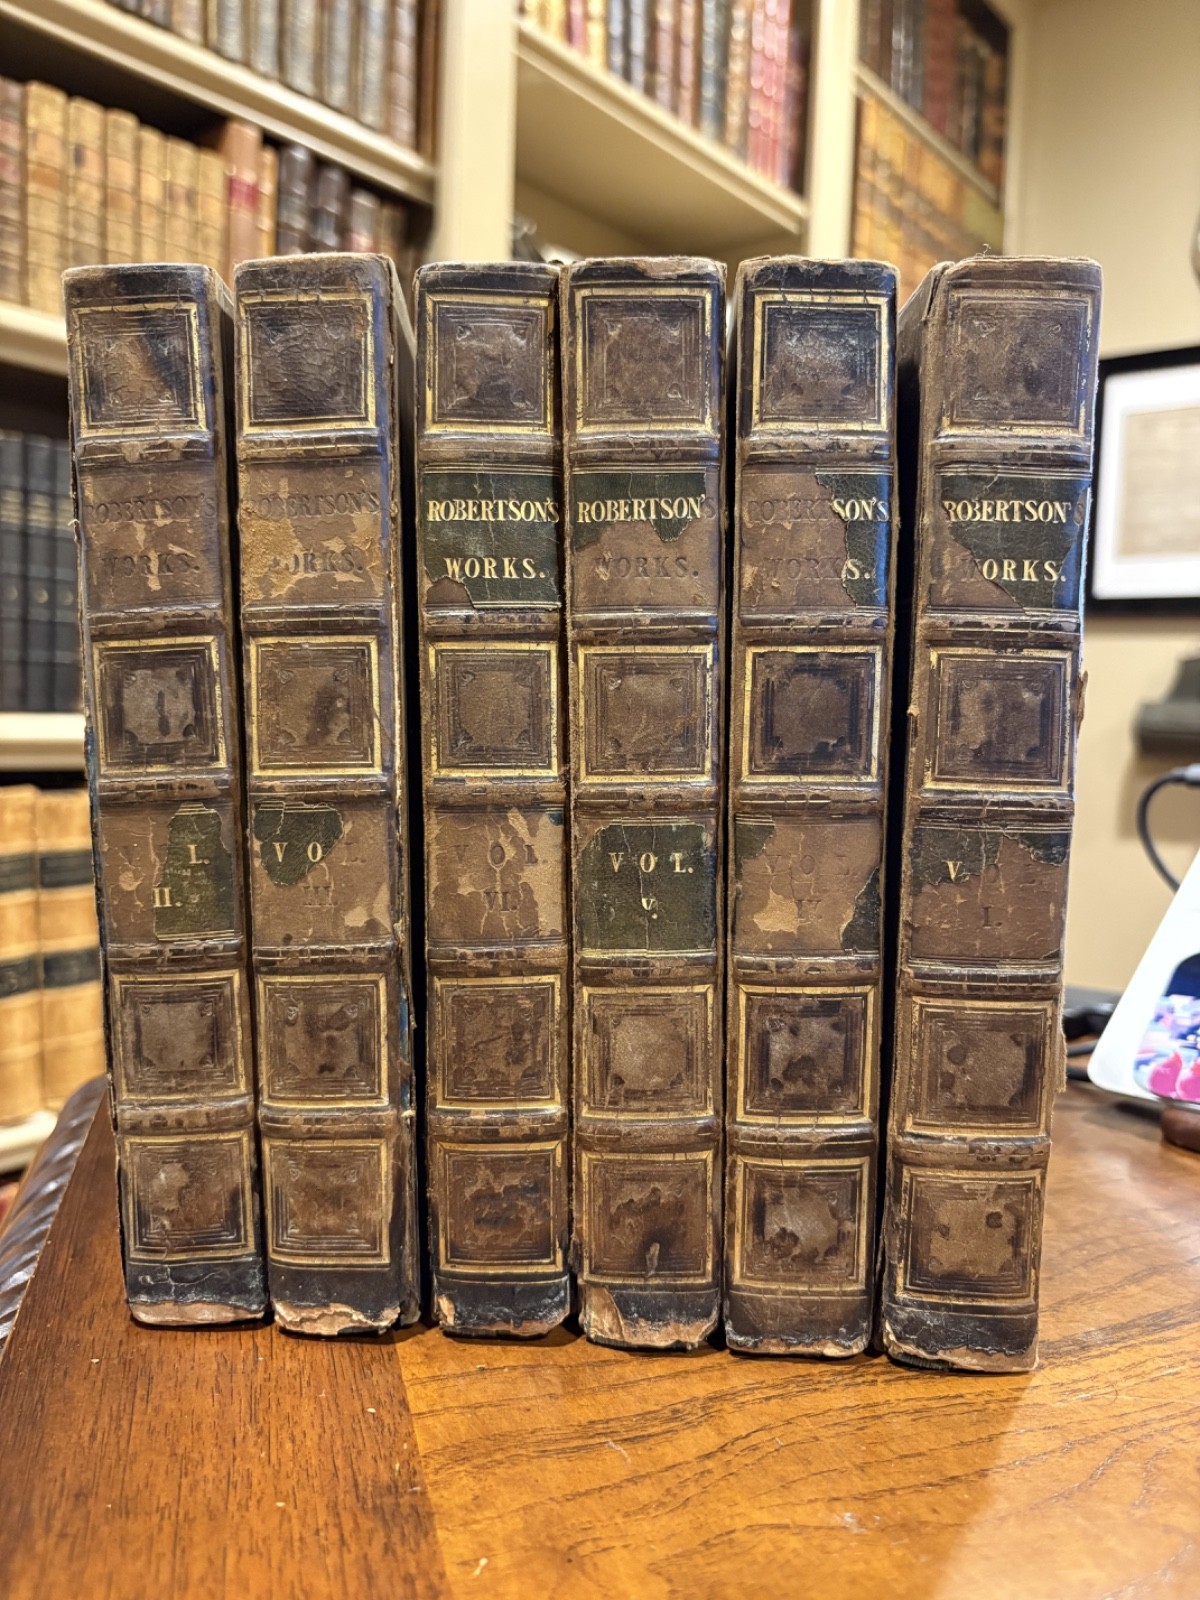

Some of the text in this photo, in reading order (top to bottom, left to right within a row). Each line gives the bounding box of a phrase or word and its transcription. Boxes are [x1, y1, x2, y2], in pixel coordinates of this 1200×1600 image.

[427, 496, 559, 523] ROBERTSON'S
[443, 556, 546, 580] WORKS.
[608, 851, 695, 875] VOL.
